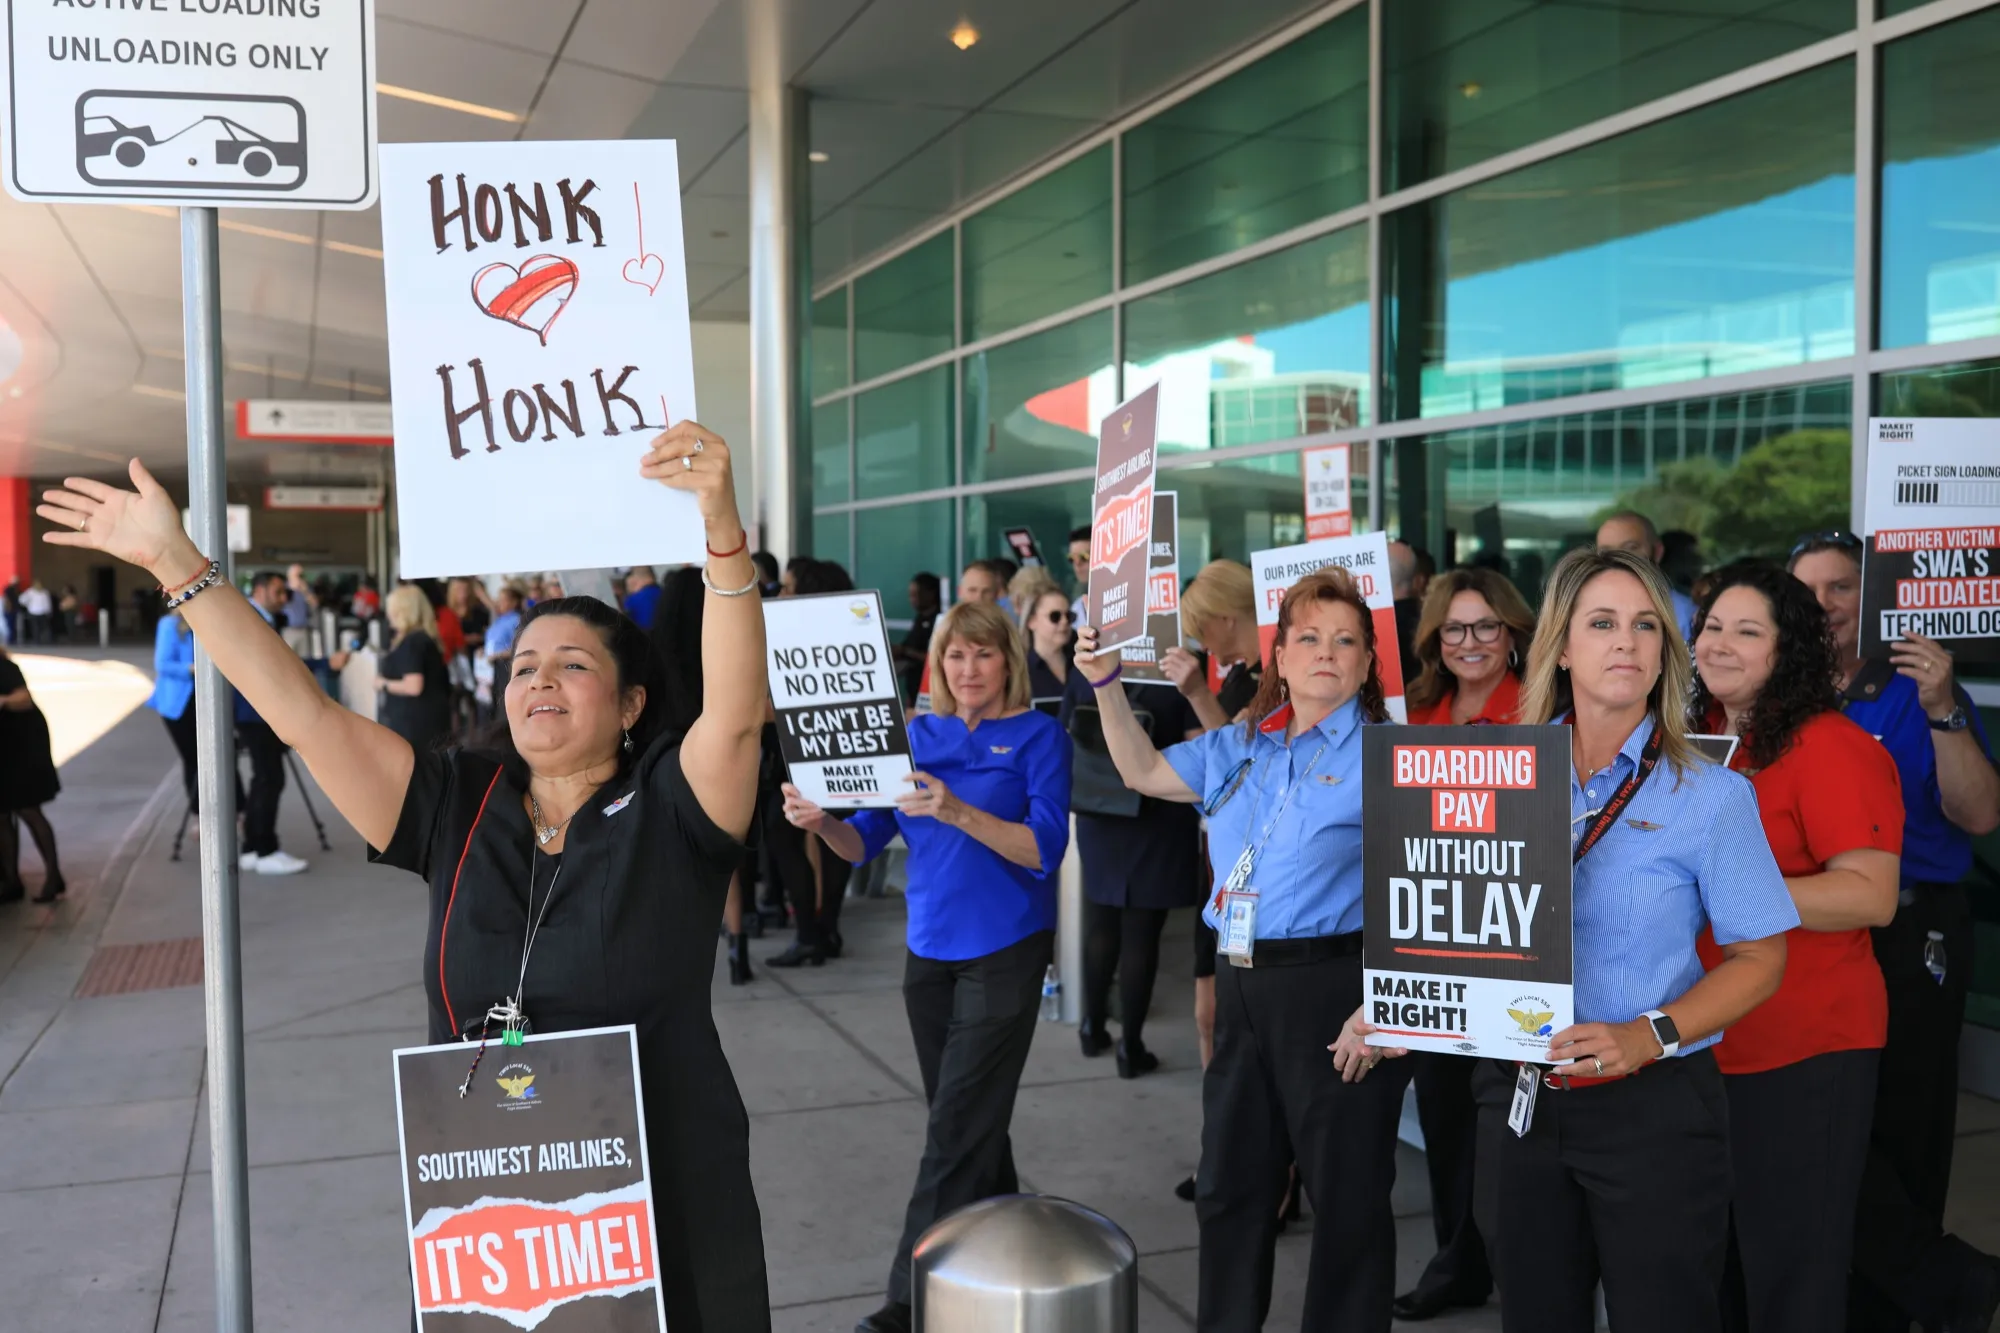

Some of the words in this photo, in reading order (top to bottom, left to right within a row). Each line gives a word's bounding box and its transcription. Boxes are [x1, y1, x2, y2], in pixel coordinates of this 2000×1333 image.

[48, 35, 237, 67] UNLOADING
[248, 43, 329, 71] ONLY
[427, 172, 607, 255] HONK
[436, 357, 647, 460] HONK
[1879, 423, 1904, 431] MAKE
[1905, 423, 1914, 431] IT
[1879, 431, 1914, 440] RIGHT!
[1098, 461, 1128, 494] SOUTHWEST
[1897, 465, 1931, 478] PICKET
[1934, 465, 1957, 478] SIGN
[1959, 465, 2000, 478] LOADING
[1093, 519, 1114, 565] IT'S
[1116, 493, 1149, 553] TIME!
[1877, 530, 1943, 551] ANOTHER
[1946, 527, 1996, 548] VICTIM
[1149, 542, 1173, 557] LINES,
[1912, 548, 1989, 579] SWA'S
[1264, 567, 1285, 581] OUR
[1355, 550, 1376, 567] ARE
[1102, 586, 1120, 606] MAKE
[1120, 582, 1128, 599] IT
[1148, 577, 1175, 609] ME!
[1898, 579, 2000, 608] OUTDATED
[1102, 599, 1128, 625] RIGHT!
[773, 647, 807, 671] NO
[811, 643, 876, 668] FOOD
[1121, 648, 1156, 663] RIGHT!
[784, 672, 818, 697] NO
[823, 670, 876, 695] REST
[785, 713, 796, 736] I
[797, 706, 860, 735] CAN'T
[863, 703, 894, 728] BE
[799, 732, 832, 758] MY
[836, 728, 889, 755] BEST
[822, 764, 862, 777] MAKE
[863, 763, 875, 776] IT
[1396, 748, 1533, 787] BOARDING
[826, 777, 879, 793] RIGHT!
[1438, 791, 1489, 828] PAY
[1403, 836, 1526, 878] WITHOUT
[1388, 876, 1543, 949] DELAY
[1372, 976, 1442, 1002] MAKE
[1444, 981, 1468, 1003] IT
[1510, 995, 1524, 1007] TWU
[1523, 994, 1540, 1002] Local
[1372, 1000, 1468, 1034] RIGHT!
[416, 1144, 533, 1183] SOUTHWEST
[537, 1136, 633, 1174] AIRLINES,
[423, 1231, 510, 1303] IT'S
[513, 1213, 645, 1291] TIME!
